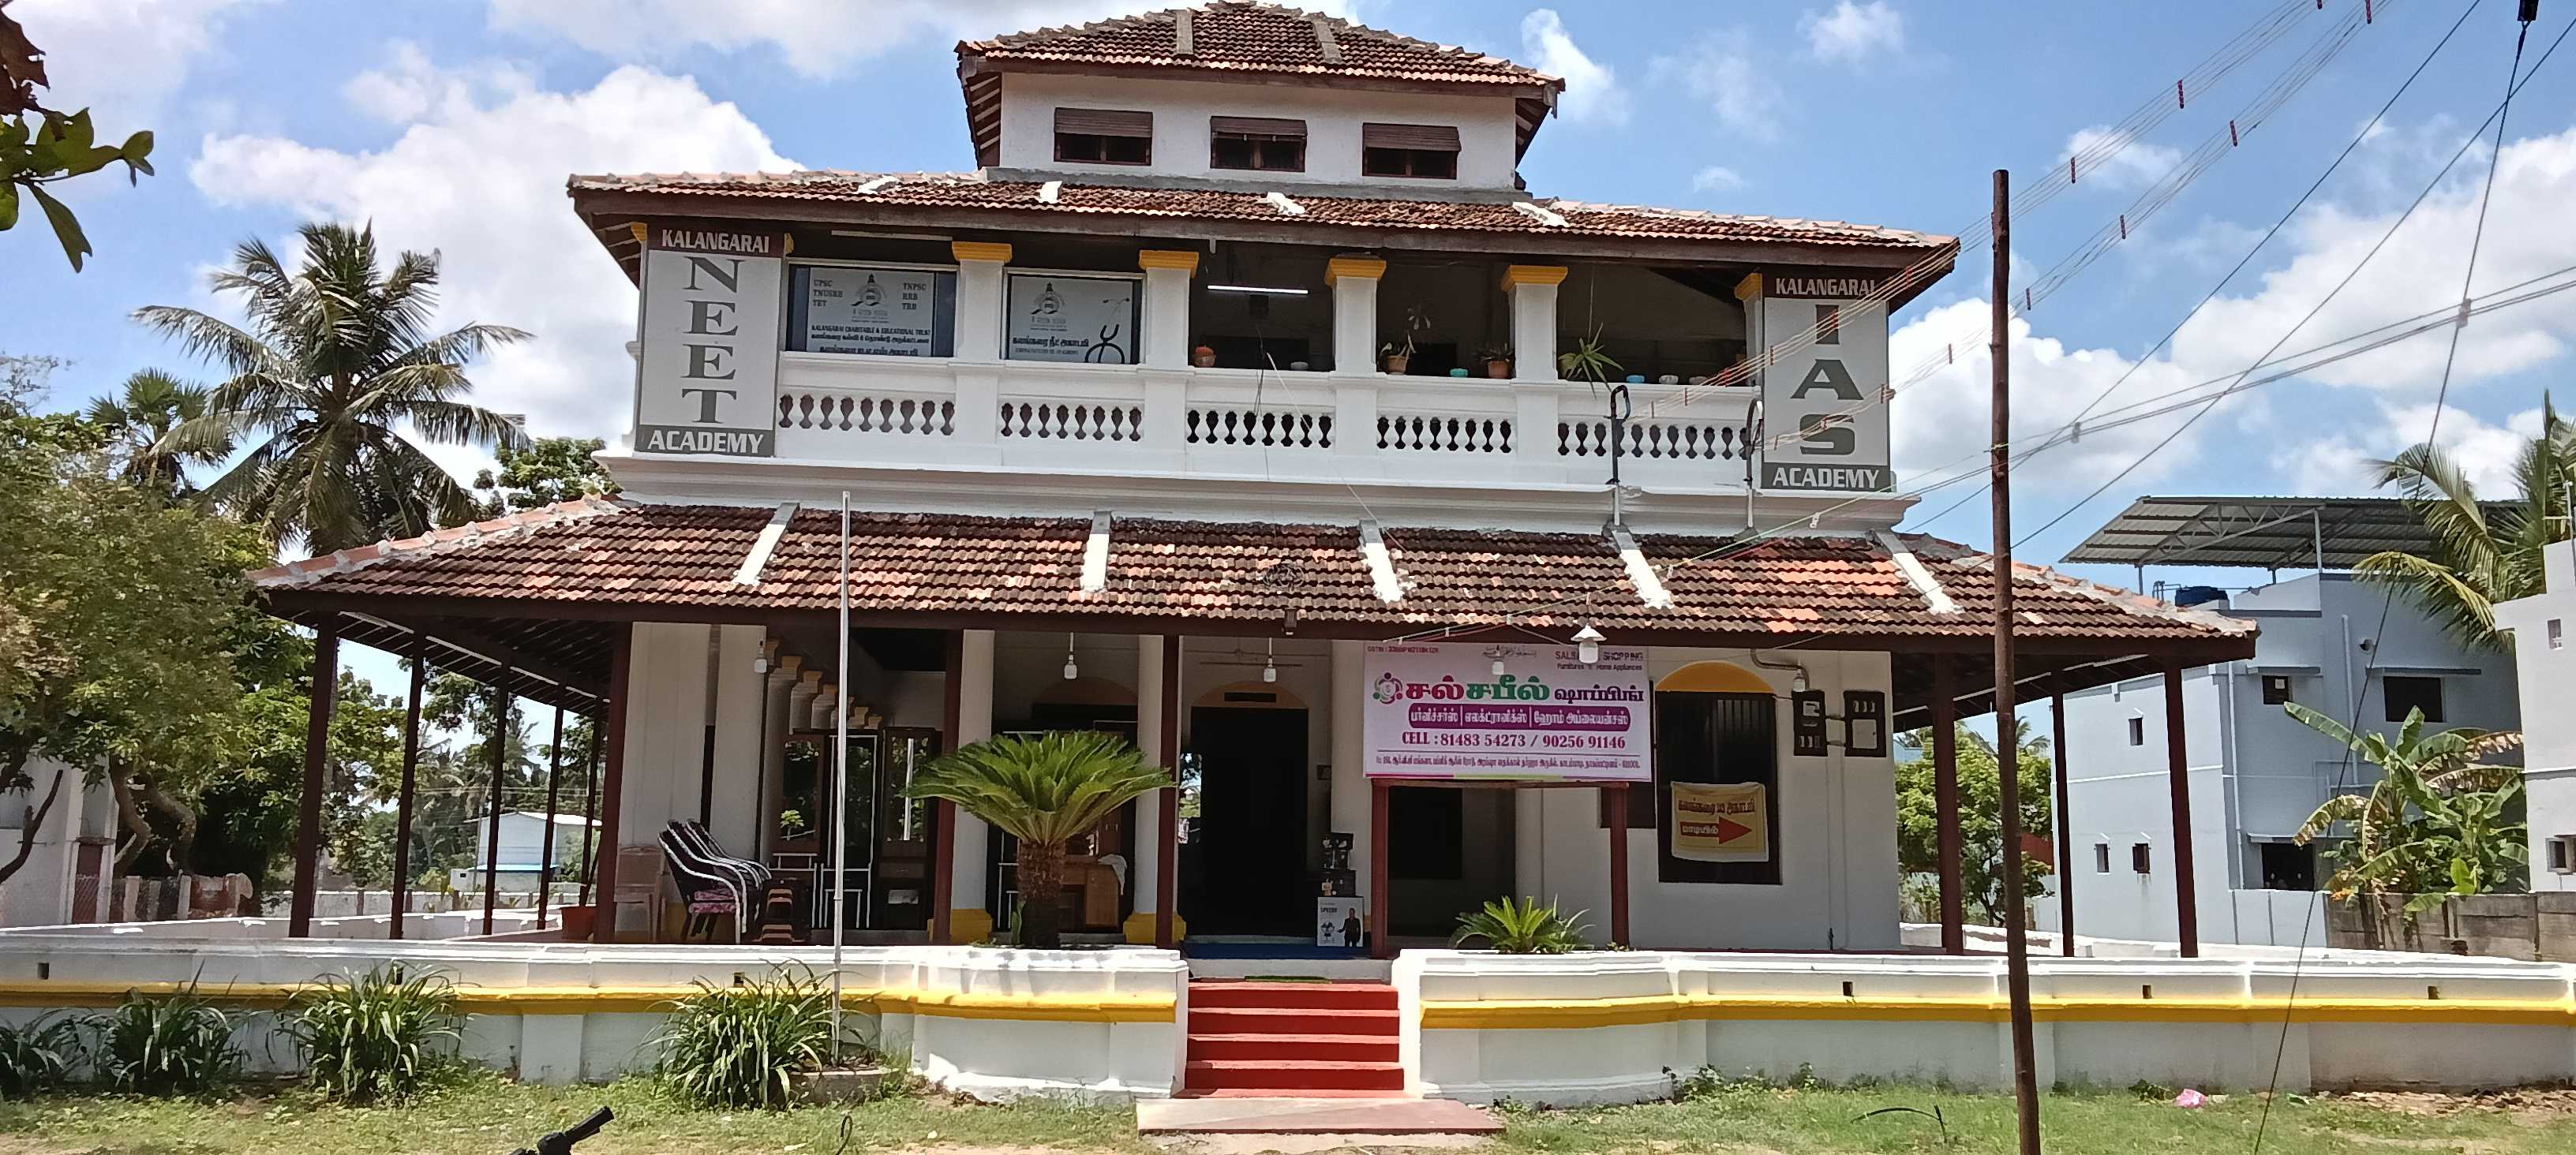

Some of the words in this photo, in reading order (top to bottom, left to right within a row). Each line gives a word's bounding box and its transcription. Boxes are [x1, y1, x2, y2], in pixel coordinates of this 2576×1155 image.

[662, 230, 769, 252] KALANGARAI
[903, 282, 927, 291] TNPSC
[1776, 278, 1875, 296] KALANGARAI
[681, 256, 746, 424] NEET
[1791, 305, 1863, 454] IAS
[647, 430, 763, 454] ACADEMY
[1773, 468, 1879, 489] ACADEMY
[1402, 732, 1429, 745] CELL
[1440, 734, 1480, 747] 81483
[1485, 734, 1526, 748] 54273
[1543, 735, 1584, 749] 90256
[1588, 735, 1626, 749] 91146
